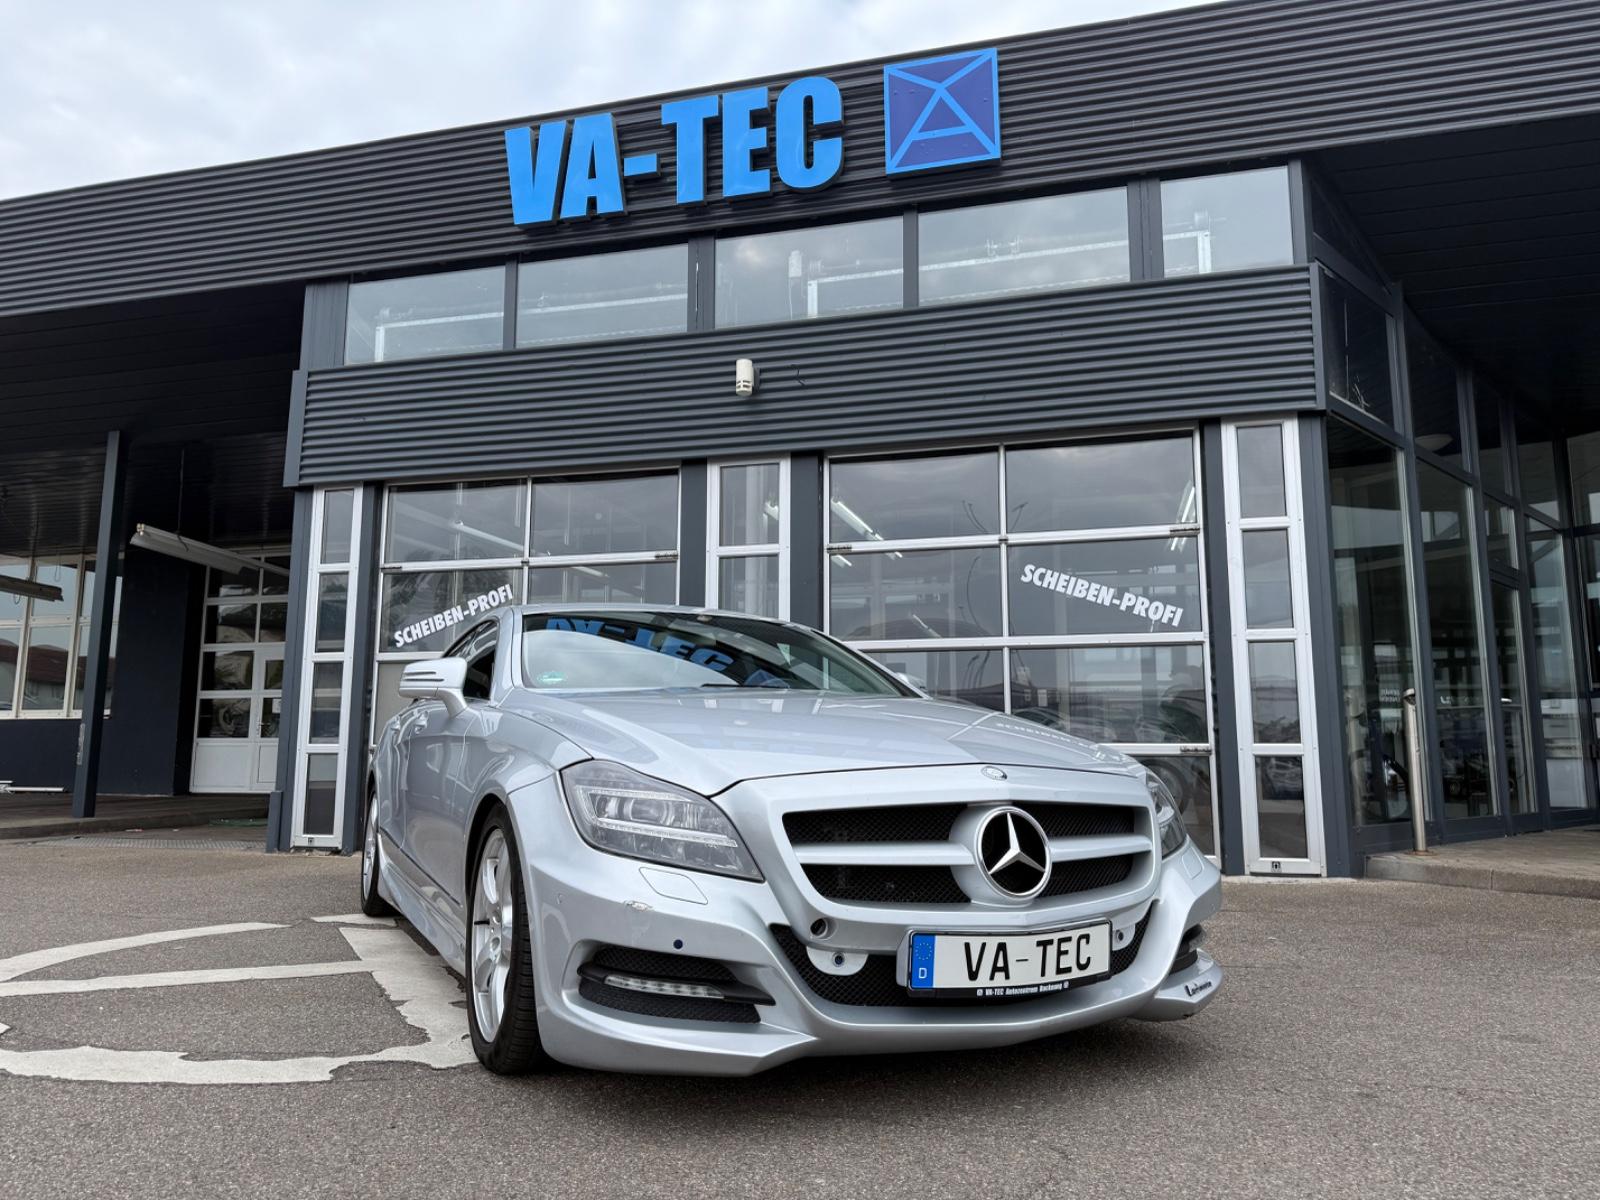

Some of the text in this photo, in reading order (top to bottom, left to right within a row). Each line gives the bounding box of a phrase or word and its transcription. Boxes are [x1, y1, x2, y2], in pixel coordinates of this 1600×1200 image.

[504, 76, 842, 226] VA-TEC
[393, 583, 513, 648] SCHEIBEN-PROFI
[1020, 563, 1184, 627] SCHEIBEN-PROFI
[918, 932, 1092, 982] D VA-TEC
